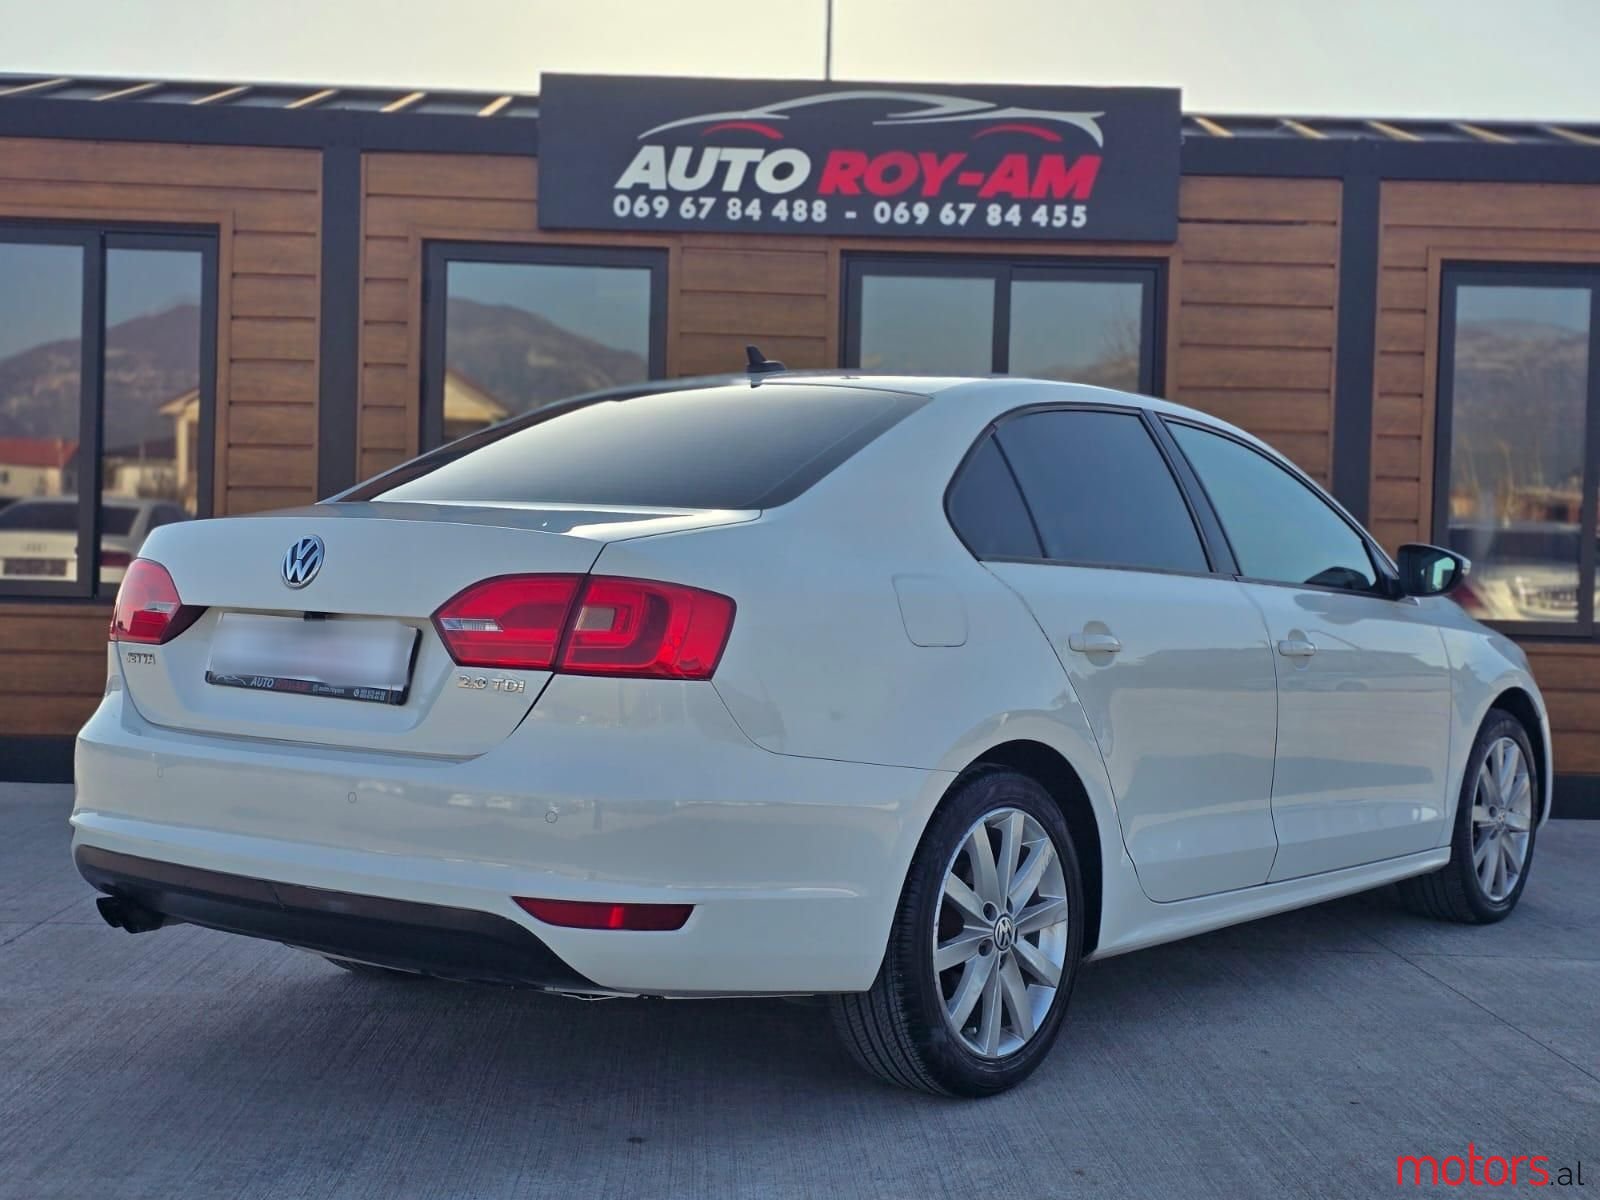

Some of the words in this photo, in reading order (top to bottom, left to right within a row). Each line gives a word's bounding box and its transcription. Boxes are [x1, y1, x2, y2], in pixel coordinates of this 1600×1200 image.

[614, 145, 812, 194] AUTO
[817, 150, 1102, 199] ROY-AM
[613, 193, 669, 219] 069
[679, 195, 716, 219] 67
[726, 196, 762, 221] 84
[771, 198, 828, 222] 488
[873, 200, 929, 225] 069
[939, 202, 976, 226] 67
[986, 203, 1022, 227] 84
[1031, 204, 1088, 228] 455
[250, 676, 275, 688] AUTO
[491, 678, 526, 694] TDI
